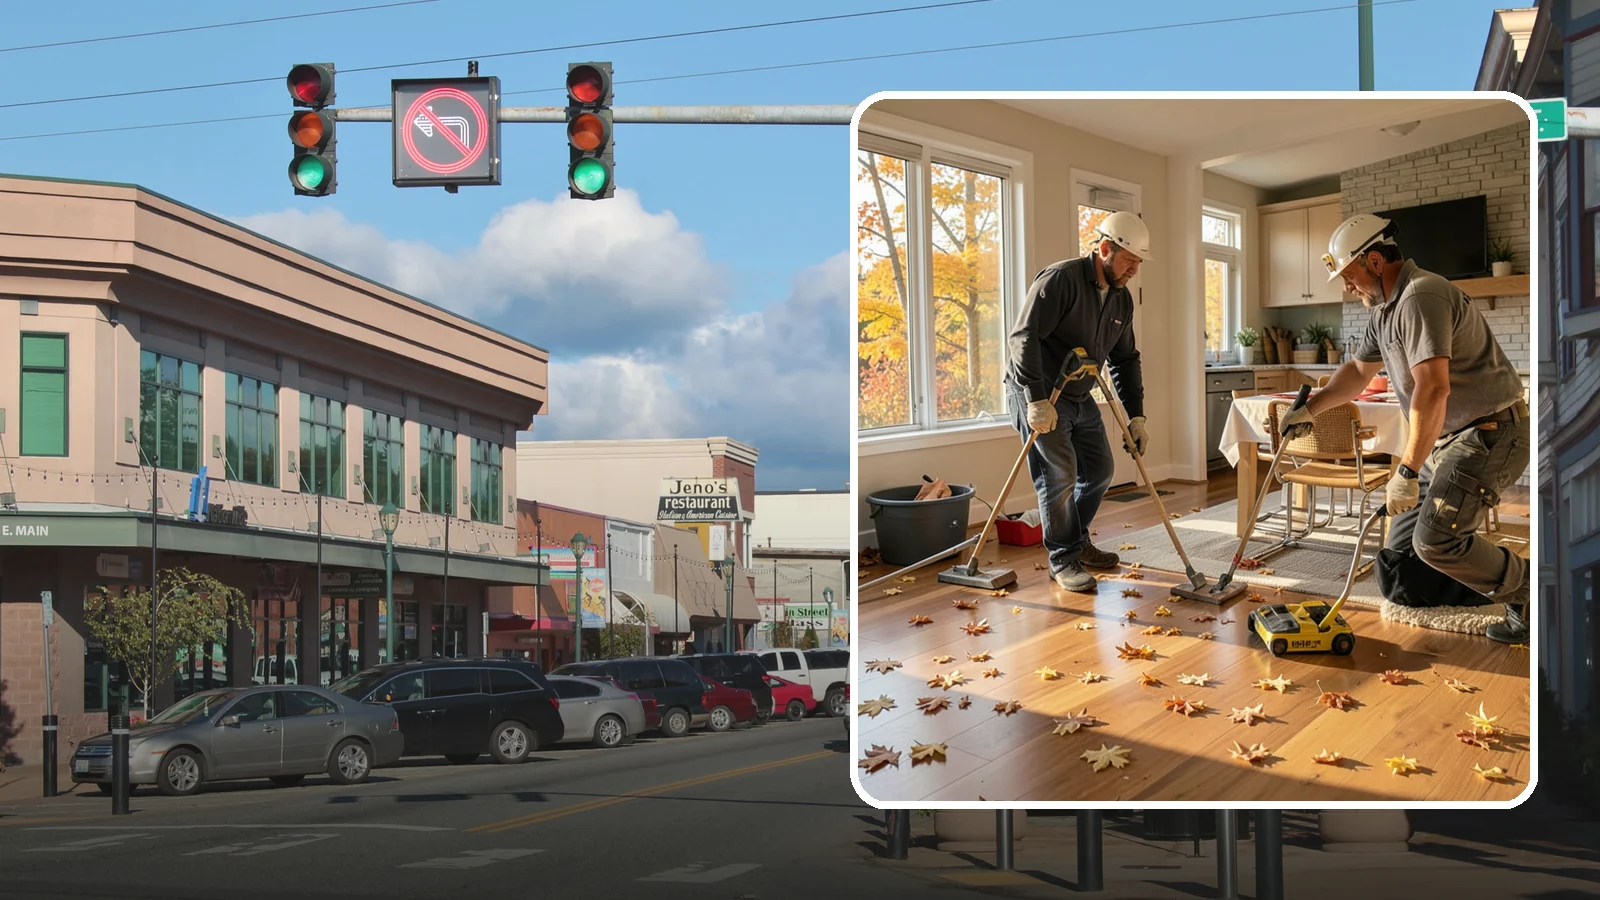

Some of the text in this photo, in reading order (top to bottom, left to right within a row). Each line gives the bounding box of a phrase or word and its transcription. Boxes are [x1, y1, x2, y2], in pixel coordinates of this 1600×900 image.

[670, 480, 727, 494] Jeno's
[665, 496, 731, 509] restaurant
[686, 510, 714, 519] American
[715, 510, 737, 518] Cuisine
[2, 525, 49, 536] E. MAIN
[798, 608, 828, 616] Street
